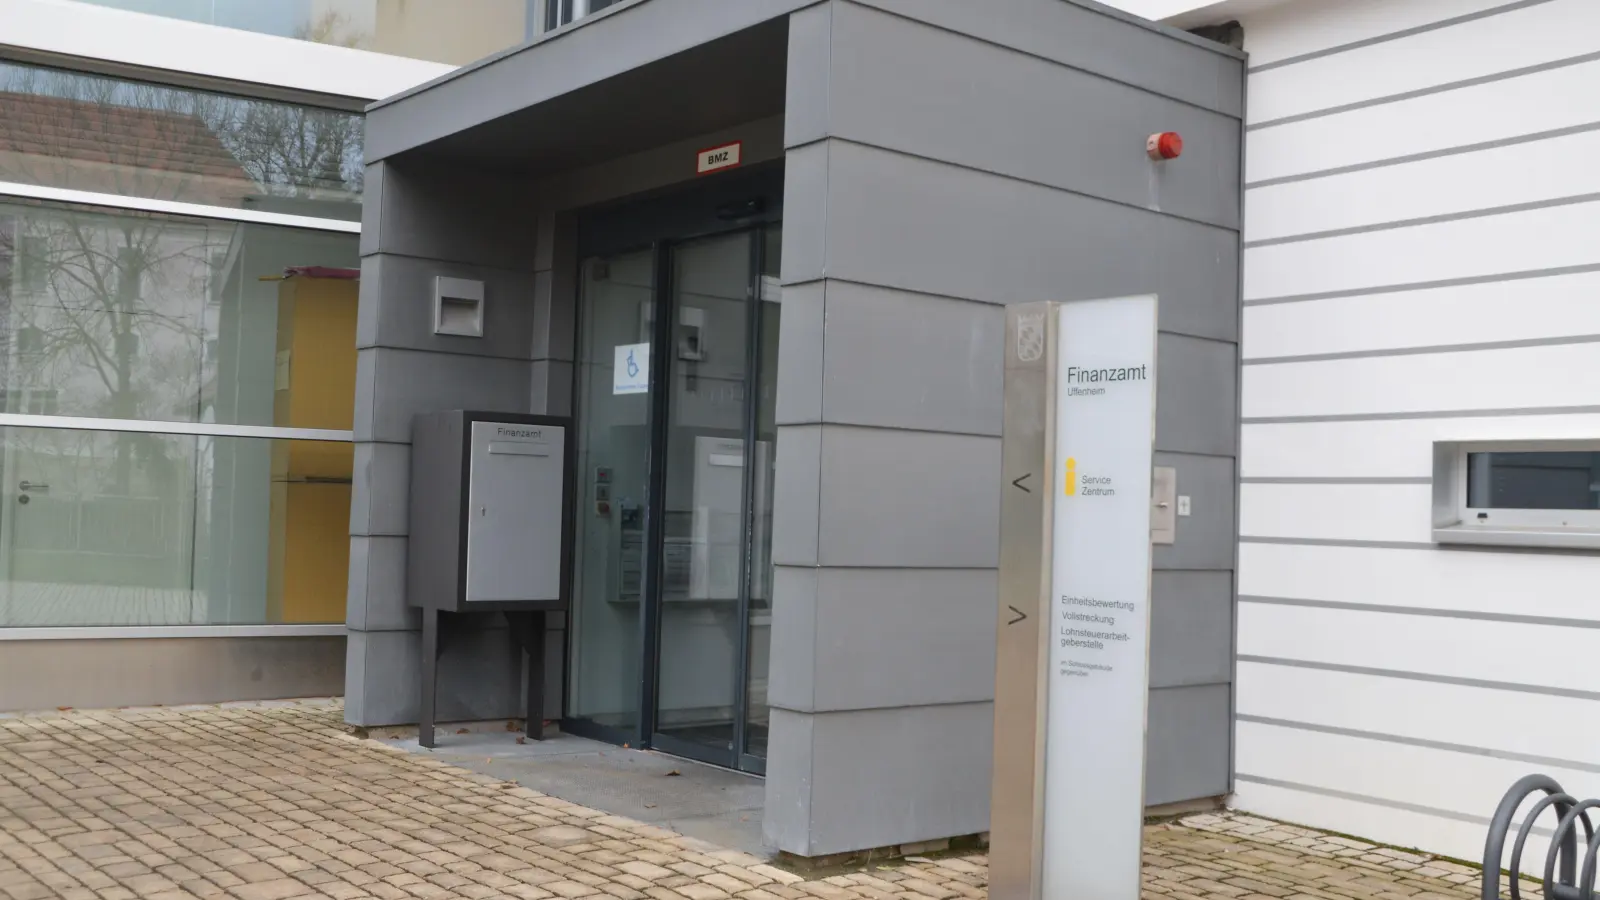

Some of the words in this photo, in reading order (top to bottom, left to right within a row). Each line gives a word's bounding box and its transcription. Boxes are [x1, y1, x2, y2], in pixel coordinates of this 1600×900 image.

[708, 151, 729, 165] BMZ
[1067, 364, 1147, 383] Finanzamt
[1067, 387, 1105, 397] Uffenheim
[497, 427, 542, 439] Finanzamt
[1081, 475, 1112, 485] Service
[1081, 486, 1115, 496] Zentrum
[1061, 595, 1135, 612] Einheitsbewertung
[1062, 611, 1115, 626] Vollstreckung
[1060, 626, 1131, 642] Lohnsteuerarbeit-
[1060, 638, 1104, 650] geberstelle
